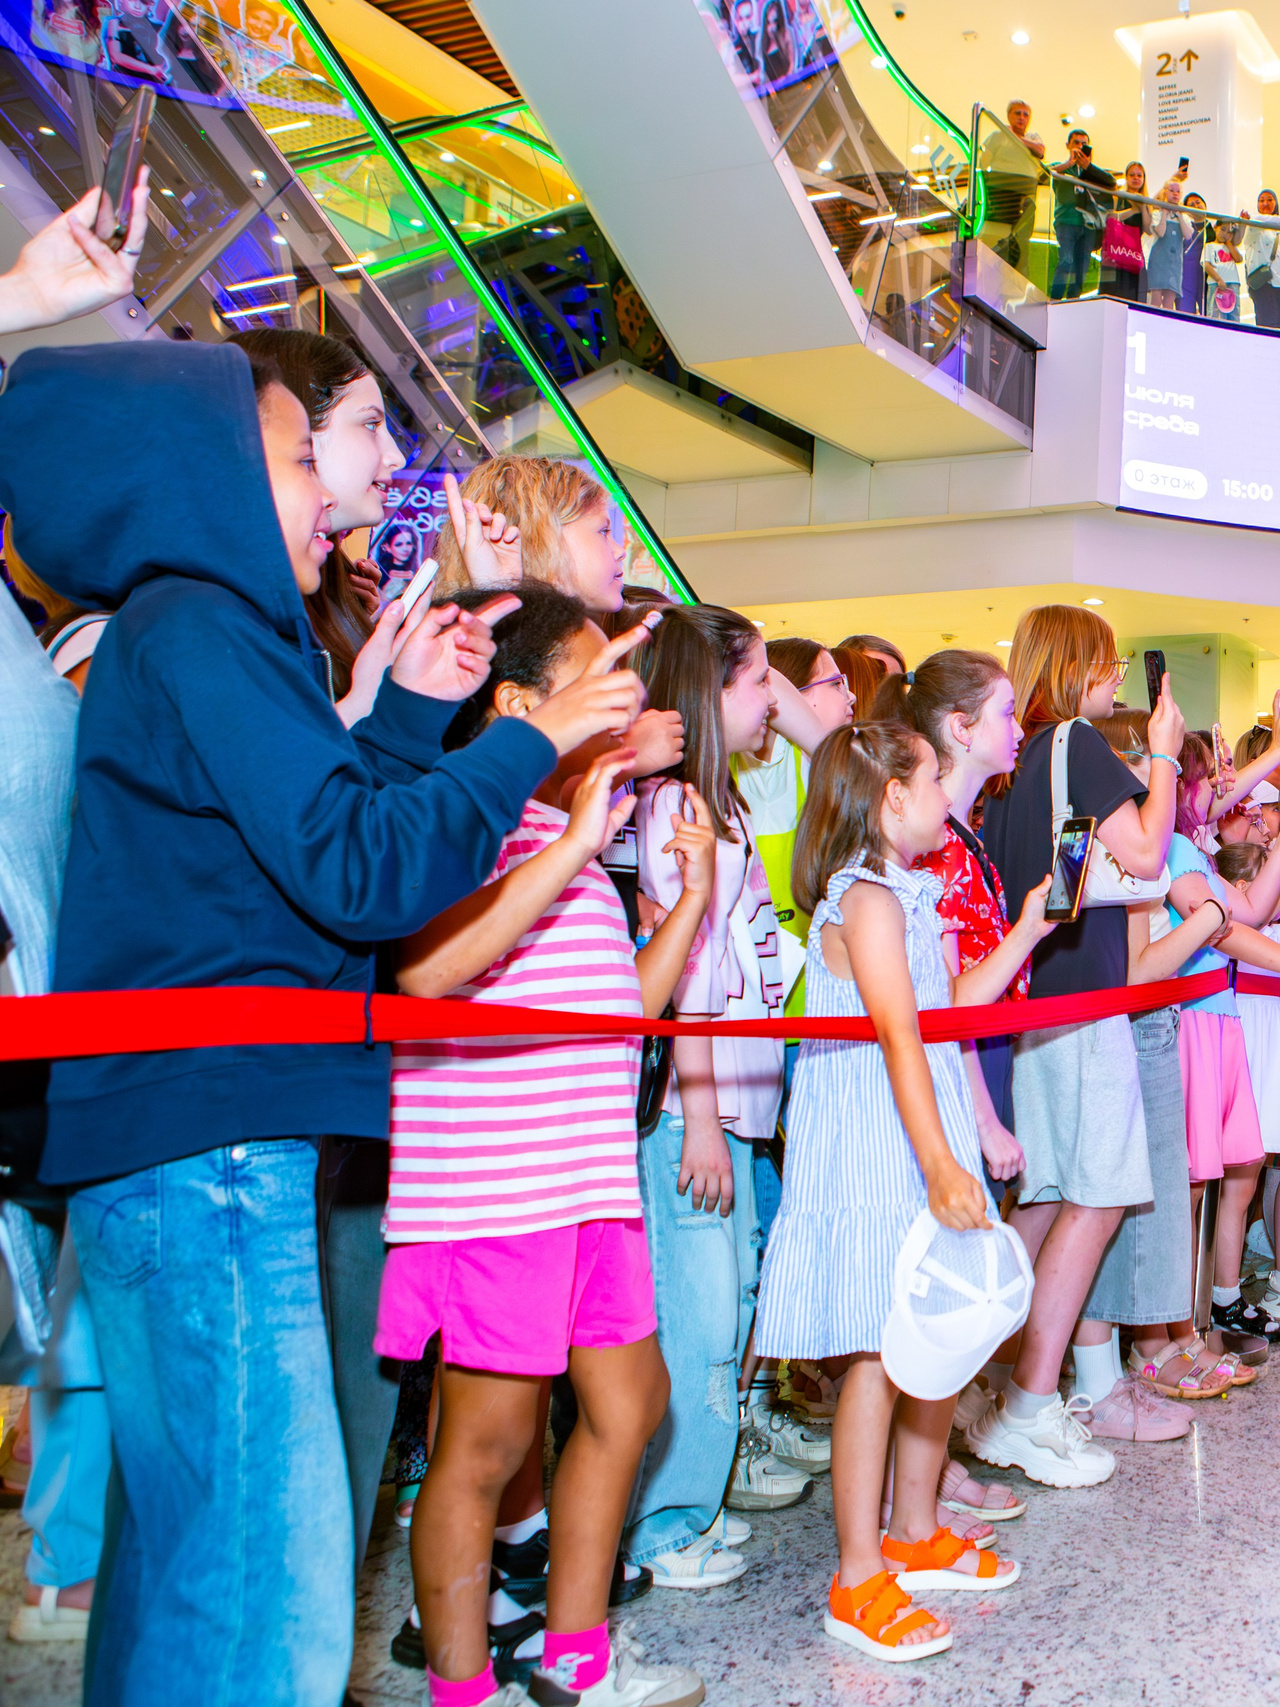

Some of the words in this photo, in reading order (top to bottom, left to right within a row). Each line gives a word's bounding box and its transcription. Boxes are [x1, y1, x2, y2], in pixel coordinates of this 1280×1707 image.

[1156, 53, 1172, 77] 2
[1158, 91, 1178, 99] GLORIA
[1178, 88, 1194, 96] JEANS
[1172, 95, 1197, 104] REPUBLIC
[1158, 106, 1179, 114] MANGO
[1110, 244, 1142, 261] MAAG
[1126, 331, 1146, 375] 1
[1124, 383, 1195, 410] июля
[1123, 409, 1200, 436] среда
[1134, 468, 1144, 482] 0
[1150, 473, 1196, 491] этаж
[1222, 478, 1274, 501] 15:00
